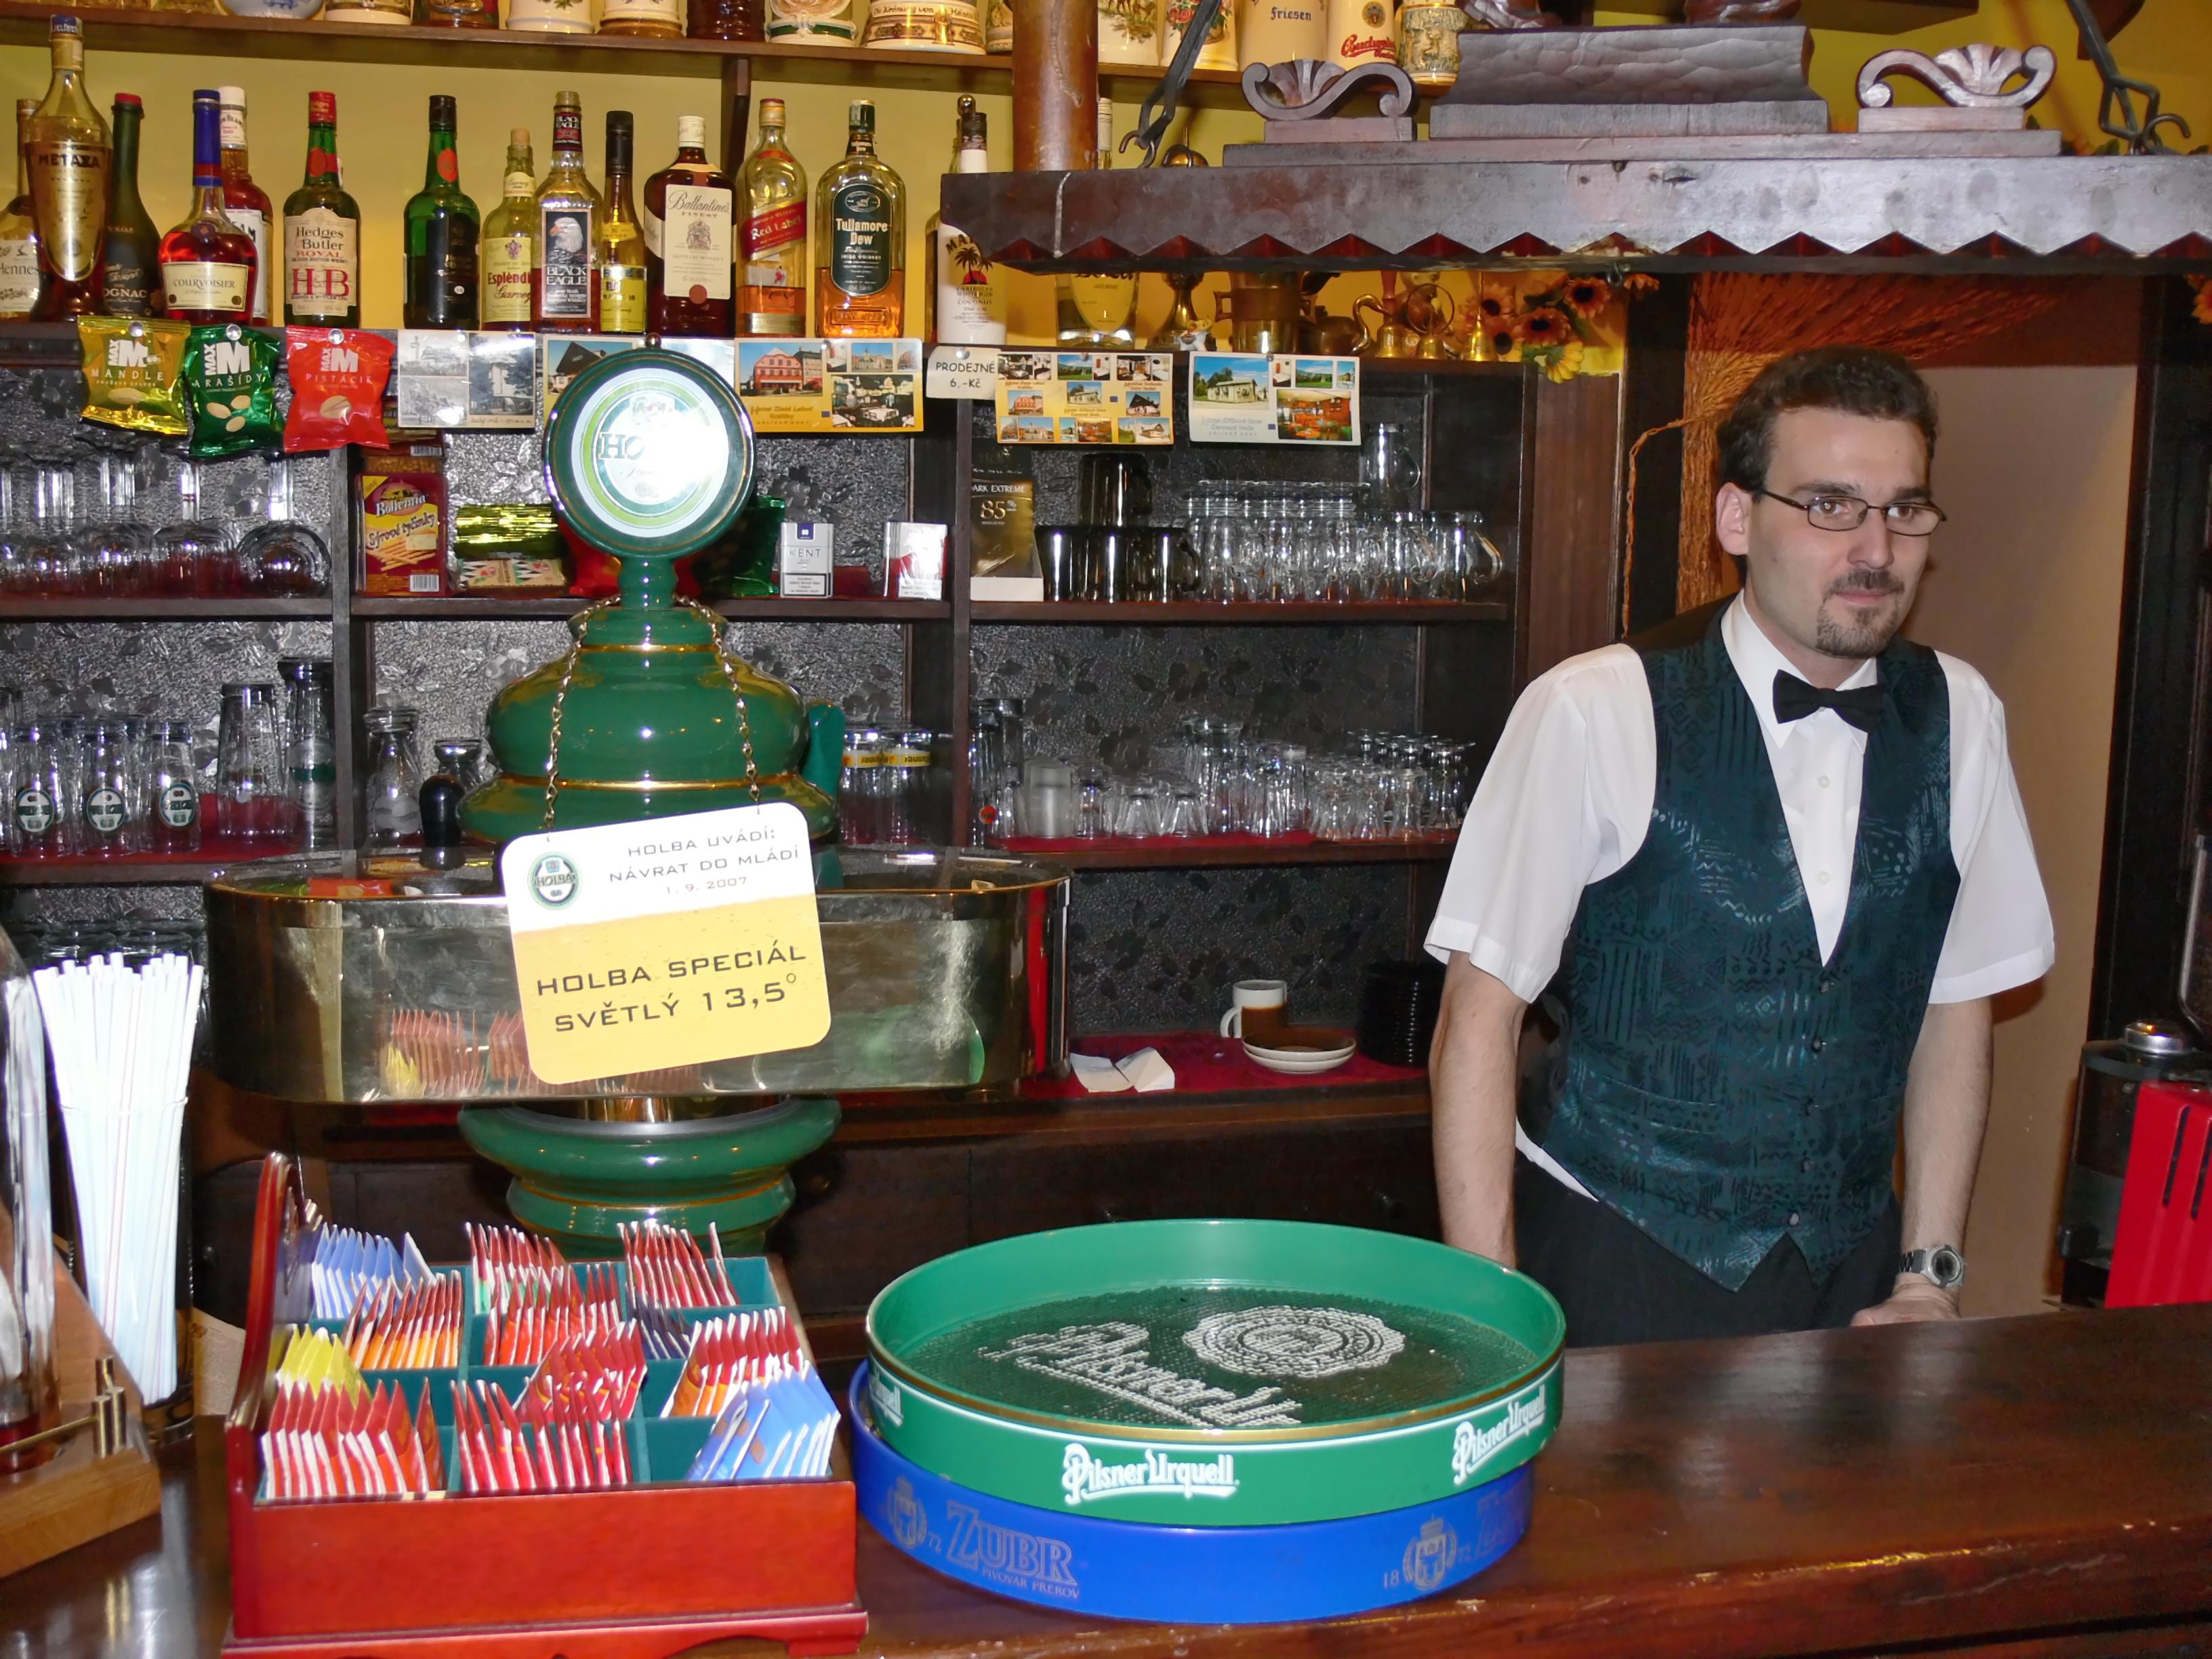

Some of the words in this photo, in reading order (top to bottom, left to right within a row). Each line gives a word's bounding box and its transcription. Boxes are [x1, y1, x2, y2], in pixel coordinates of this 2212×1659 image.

[39, 153, 100, 168] METAXA
[667, 190, 731, 214] Ballantine's
[296, 226, 344, 239] Hedges
[751, 225, 773, 240] Red
[774, 216, 802, 231] Label
[835, 218, 889, 232] Tullamore
[302, 239, 344, 251] Butler
[850, 232, 874, 245] Dew
[296, 250, 342, 258] ROYAL
[547, 265, 587, 276] BLACK
[173, 278, 235, 290] COURVOISIER
[546, 276, 587, 285] EAGLE
[103, 287, 147, 298] OGNAC
[108, 340, 119, 366] MAX
[204, 344, 217, 375] MAX
[321, 347, 331, 371] MAX
[935, 360, 996, 373] PRODEJNÉ
[91, 368, 163, 381] MANDLE
[194, 373, 262, 388] ARAŠÍDY
[991, 485, 1025, 493] EXTREME
[375, 494, 426, 518] Bohemia
[788, 548, 821, 558] KENT
[628, 840, 697, 857] HOLBA
[708, 827, 775, 847] UVÁDÍ:
[609, 863, 689, 883] NÁVRAT
[700, 858, 728, 872] DO
[738, 844, 799, 866] MLÁDÍ
[535, 873, 575, 888] HOLBA
[707, 877, 747, 889] 2007
[537, 966, 651, 996] HOLBA
[668, 939, 806, 979] SPECIÁL
[555, 992, 680, 1032] SVĚTLÝ
[1452, 1420, 1511, 1485] Pilsner
[1507, 1384, 1546, 1436] Urquell
[1061, 1442, 1149, 1505] Pilsner
[1145, 1447, 1235, 1499] Urquell
[946, 1498, 1078, 1586] ZUBR
[983, 1567, 1028, 1589] PIVOVAR
[1383, 1568, 1399, 1589] 18
